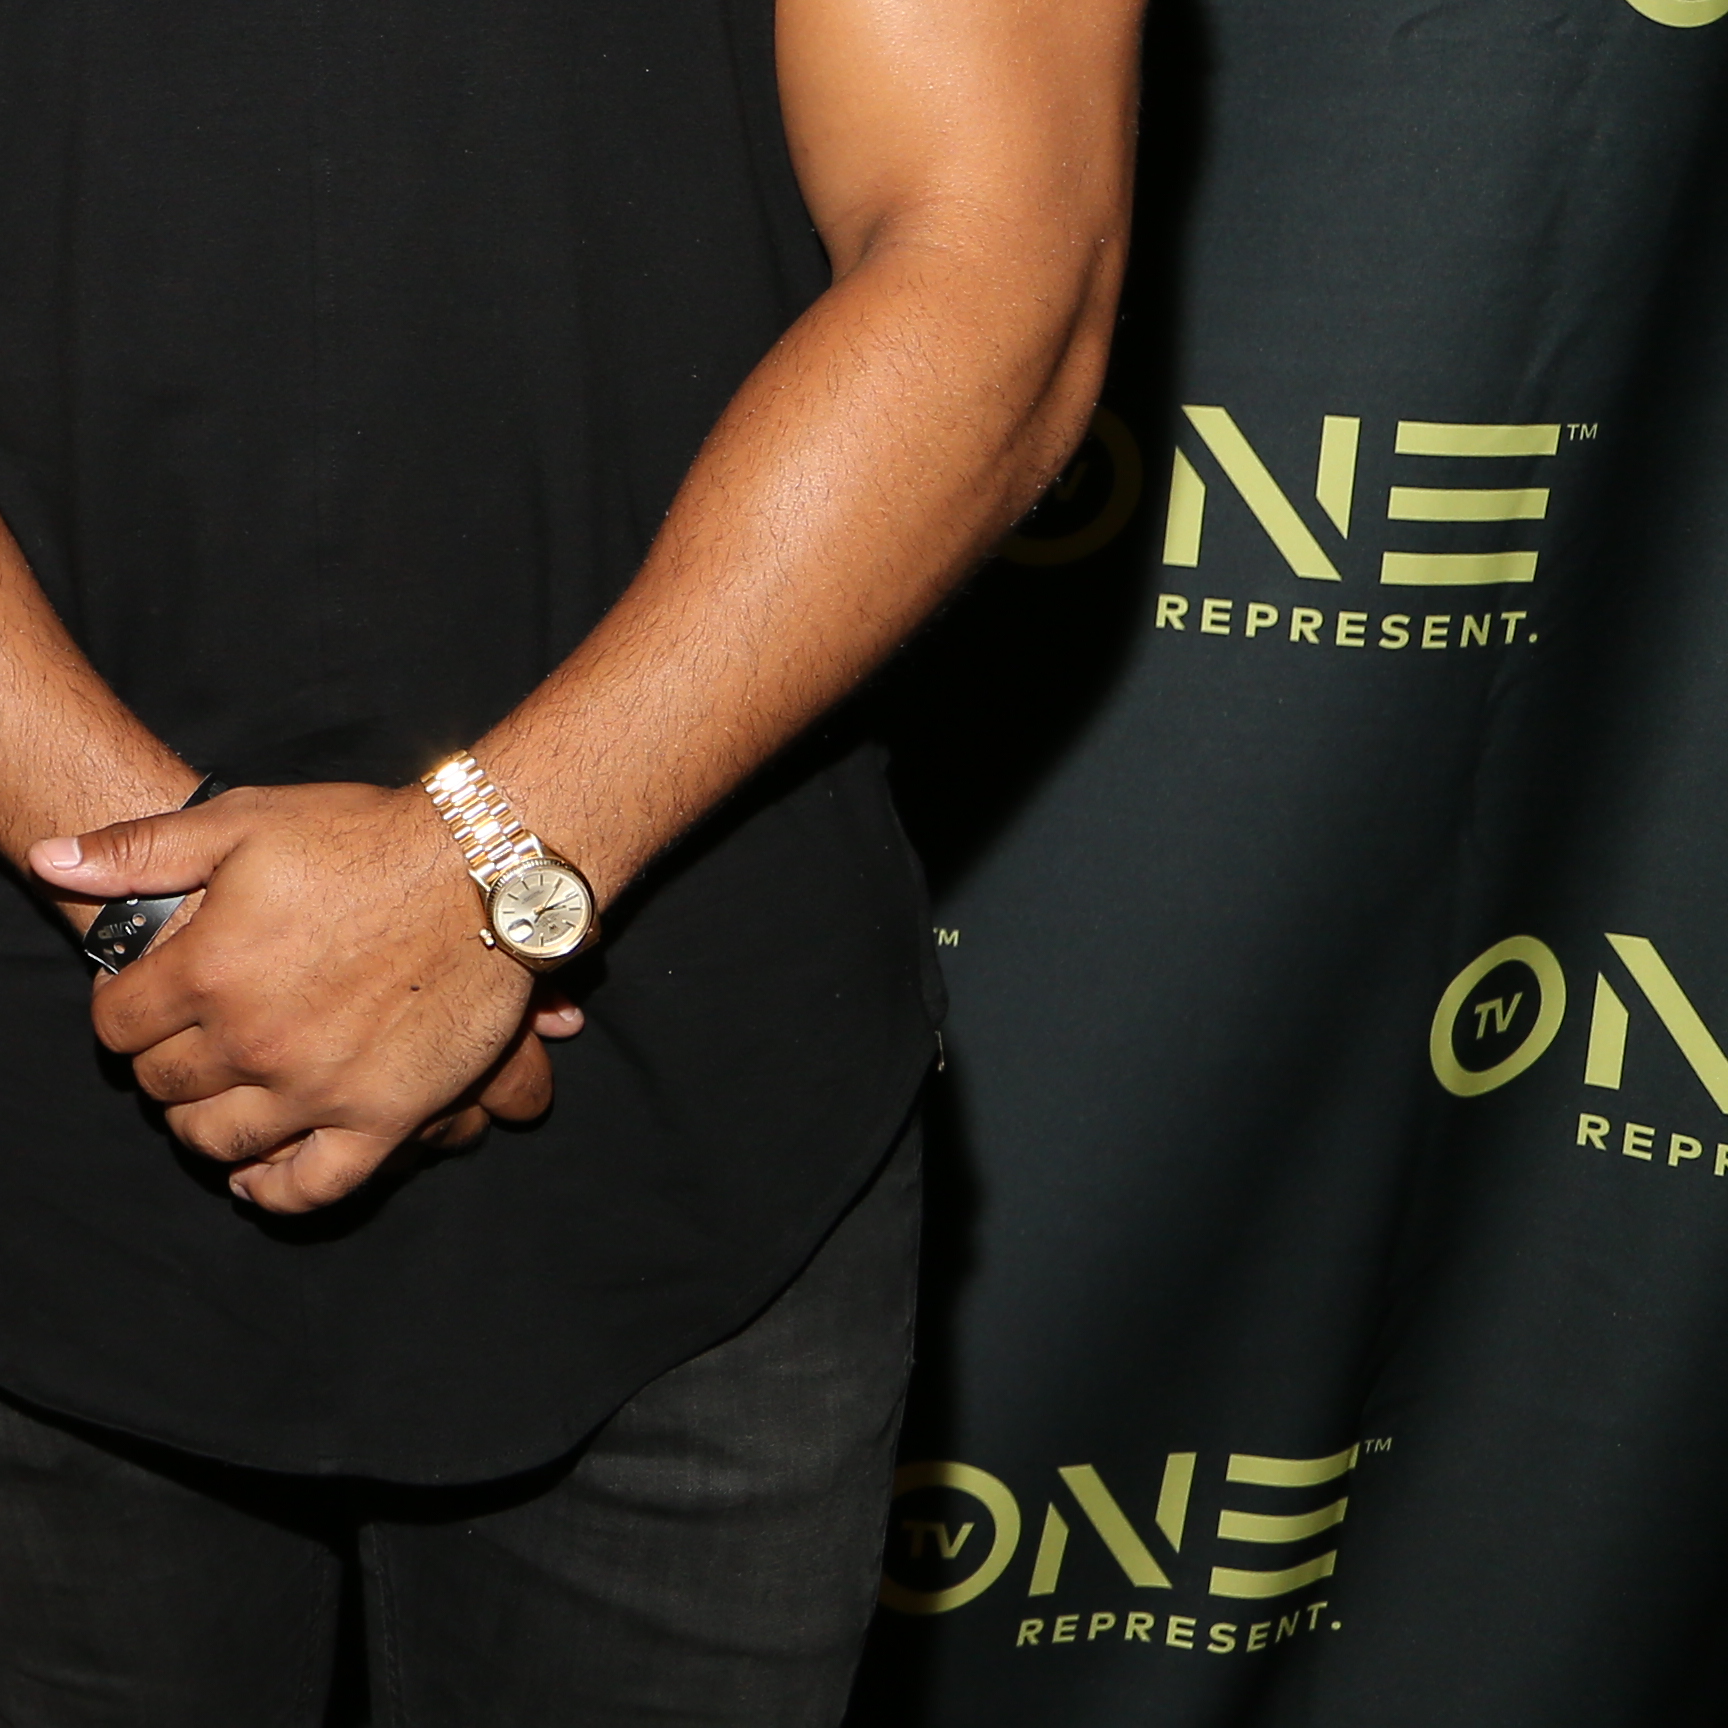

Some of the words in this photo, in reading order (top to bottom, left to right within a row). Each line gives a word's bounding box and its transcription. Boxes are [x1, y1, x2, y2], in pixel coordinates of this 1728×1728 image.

[1162, 404, 1562, 586] NE
[1155, 593, 1538, 650] REPRESENT.
[1429, 932, 1728, 1115] ON
[1474, 992, 1523, 1039] TV
[901, 1519, 976, 1560] TV
[1016, 1601, 1342, 1655] REPRESENT.
